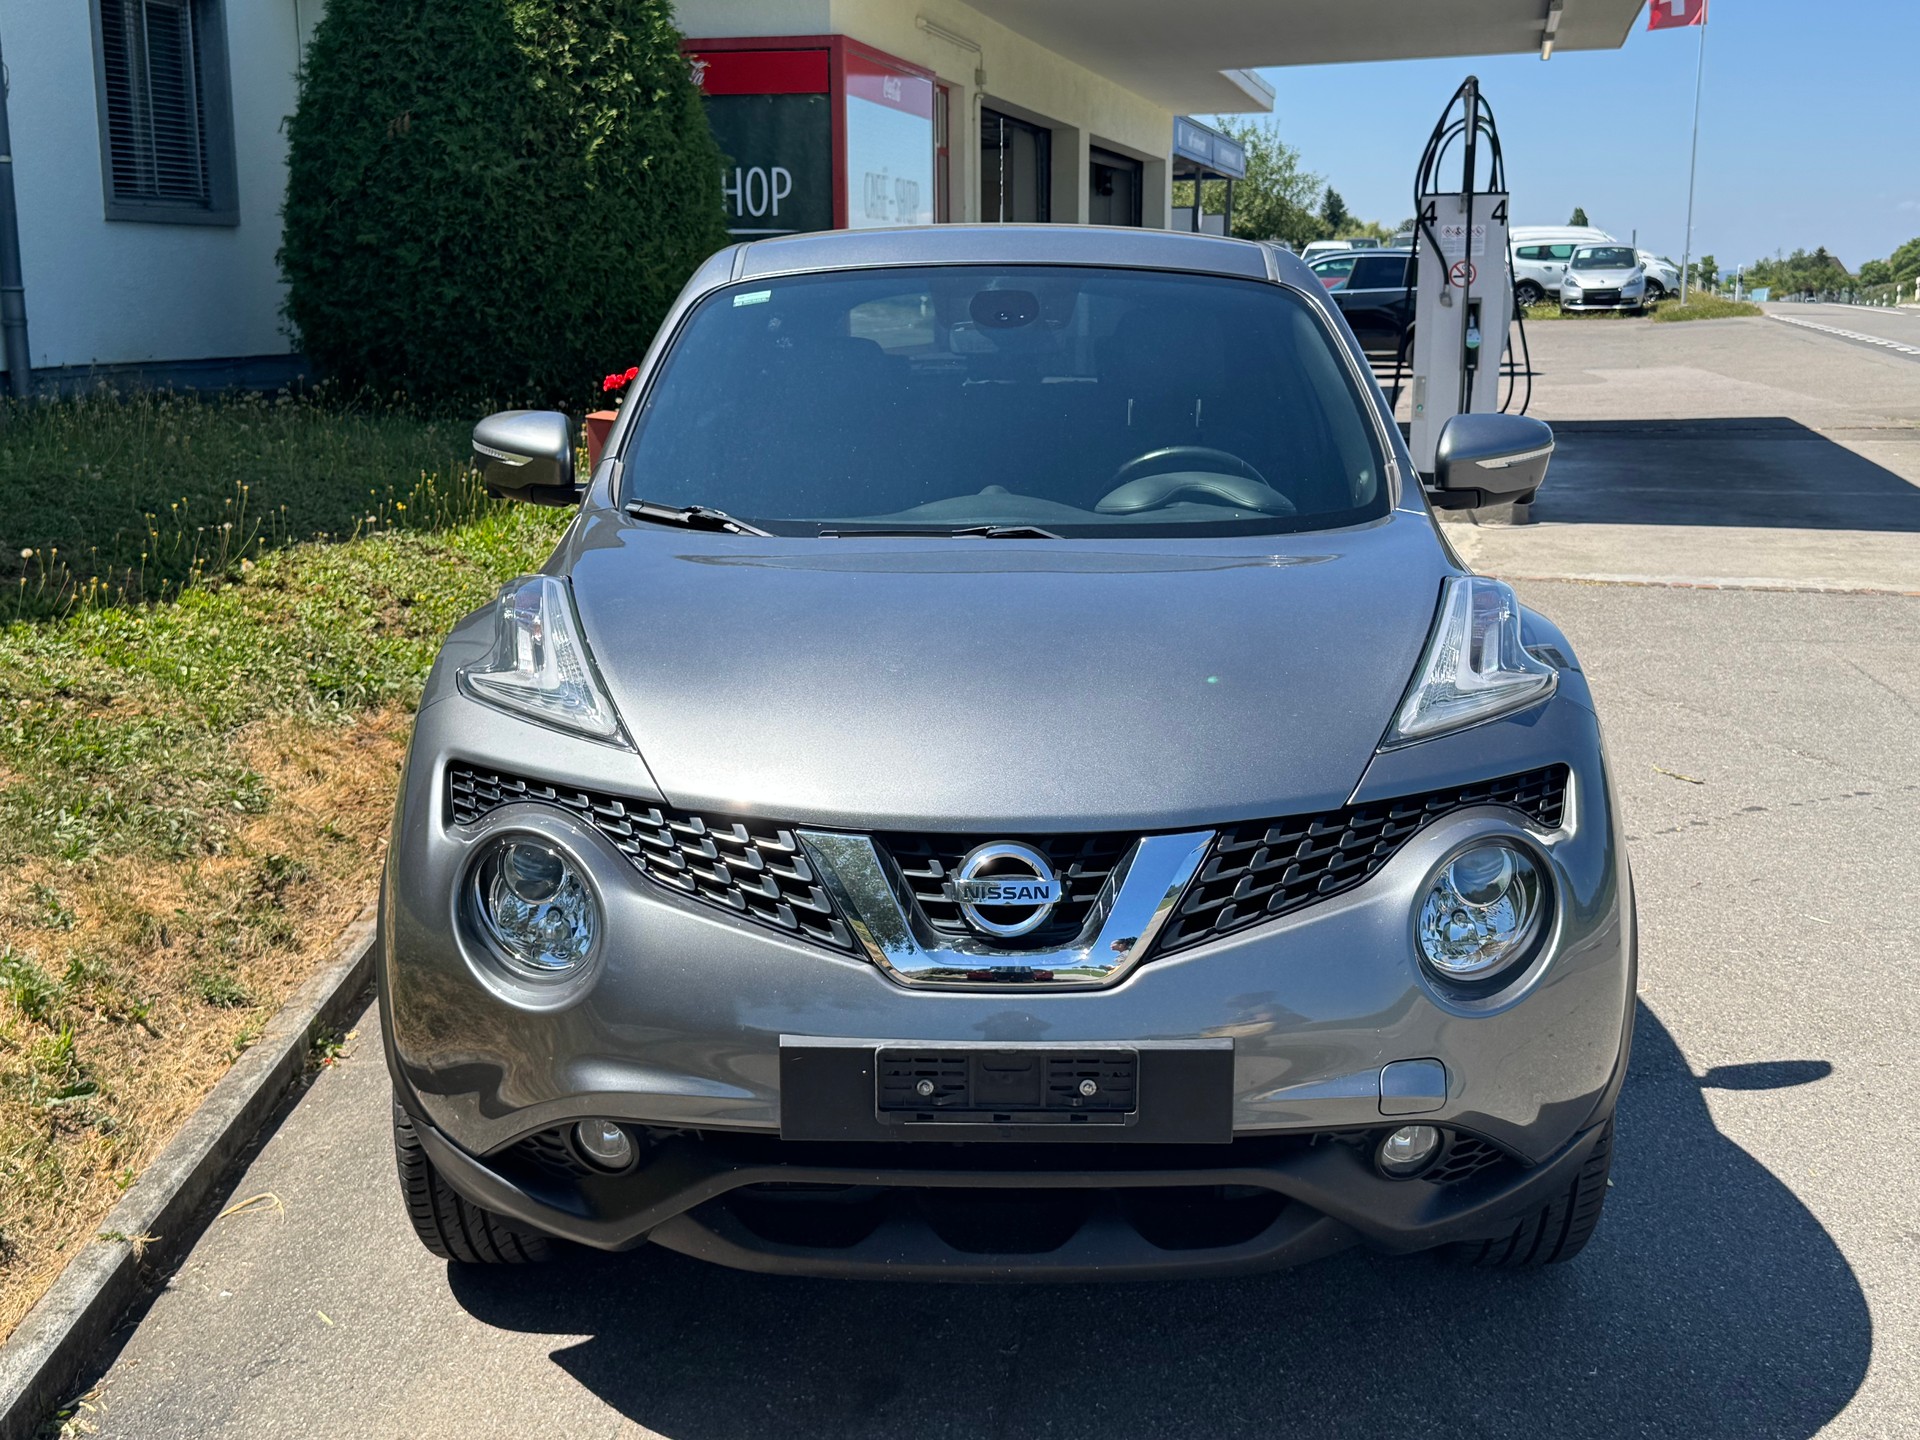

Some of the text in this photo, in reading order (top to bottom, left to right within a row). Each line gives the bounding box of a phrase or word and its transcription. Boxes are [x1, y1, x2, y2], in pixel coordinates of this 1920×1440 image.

[721, 166, 792, 217] HOP
[1421, 200, 1437, 227] 4
[1491, 199, 1508, 226] 4
[964, 886, 1049, 899] NISSAN
